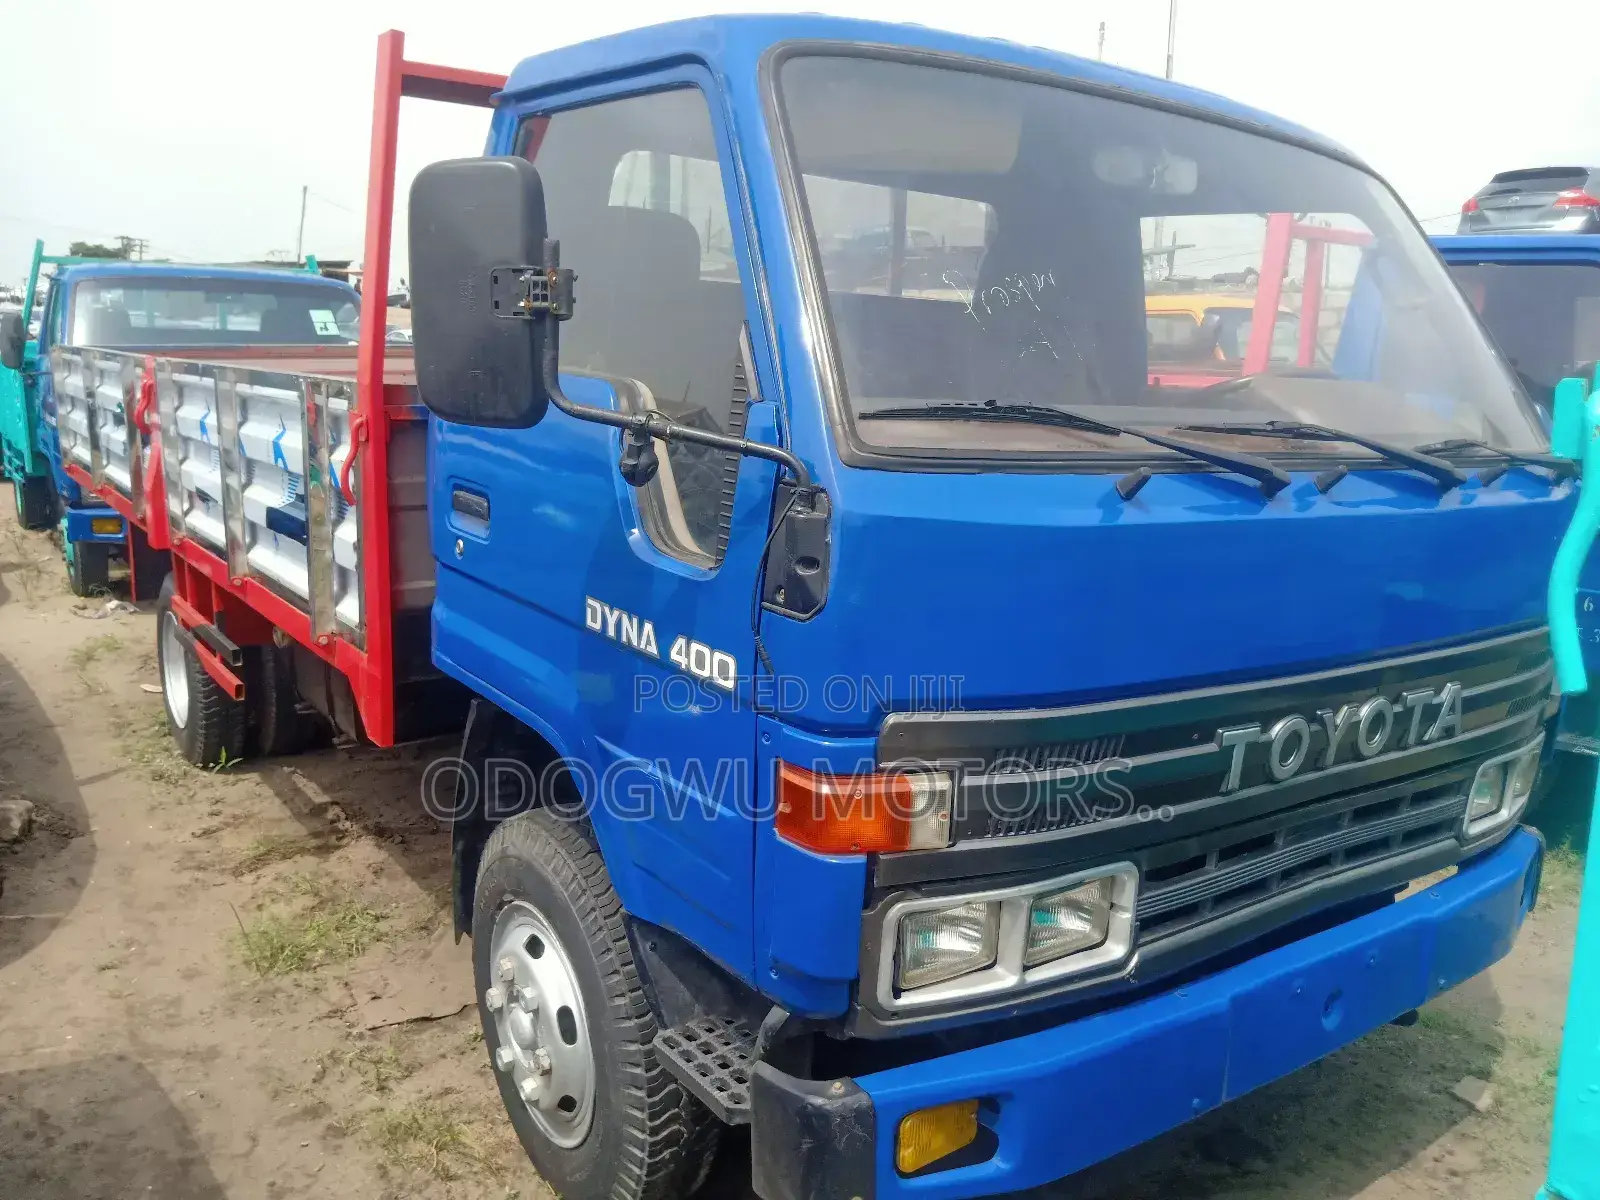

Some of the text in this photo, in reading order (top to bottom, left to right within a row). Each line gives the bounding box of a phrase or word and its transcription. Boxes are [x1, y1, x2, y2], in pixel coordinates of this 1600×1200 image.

[586, 595, 737, 692] DYNA 400
[1214, 681, 1463, 793] TOYOTA
